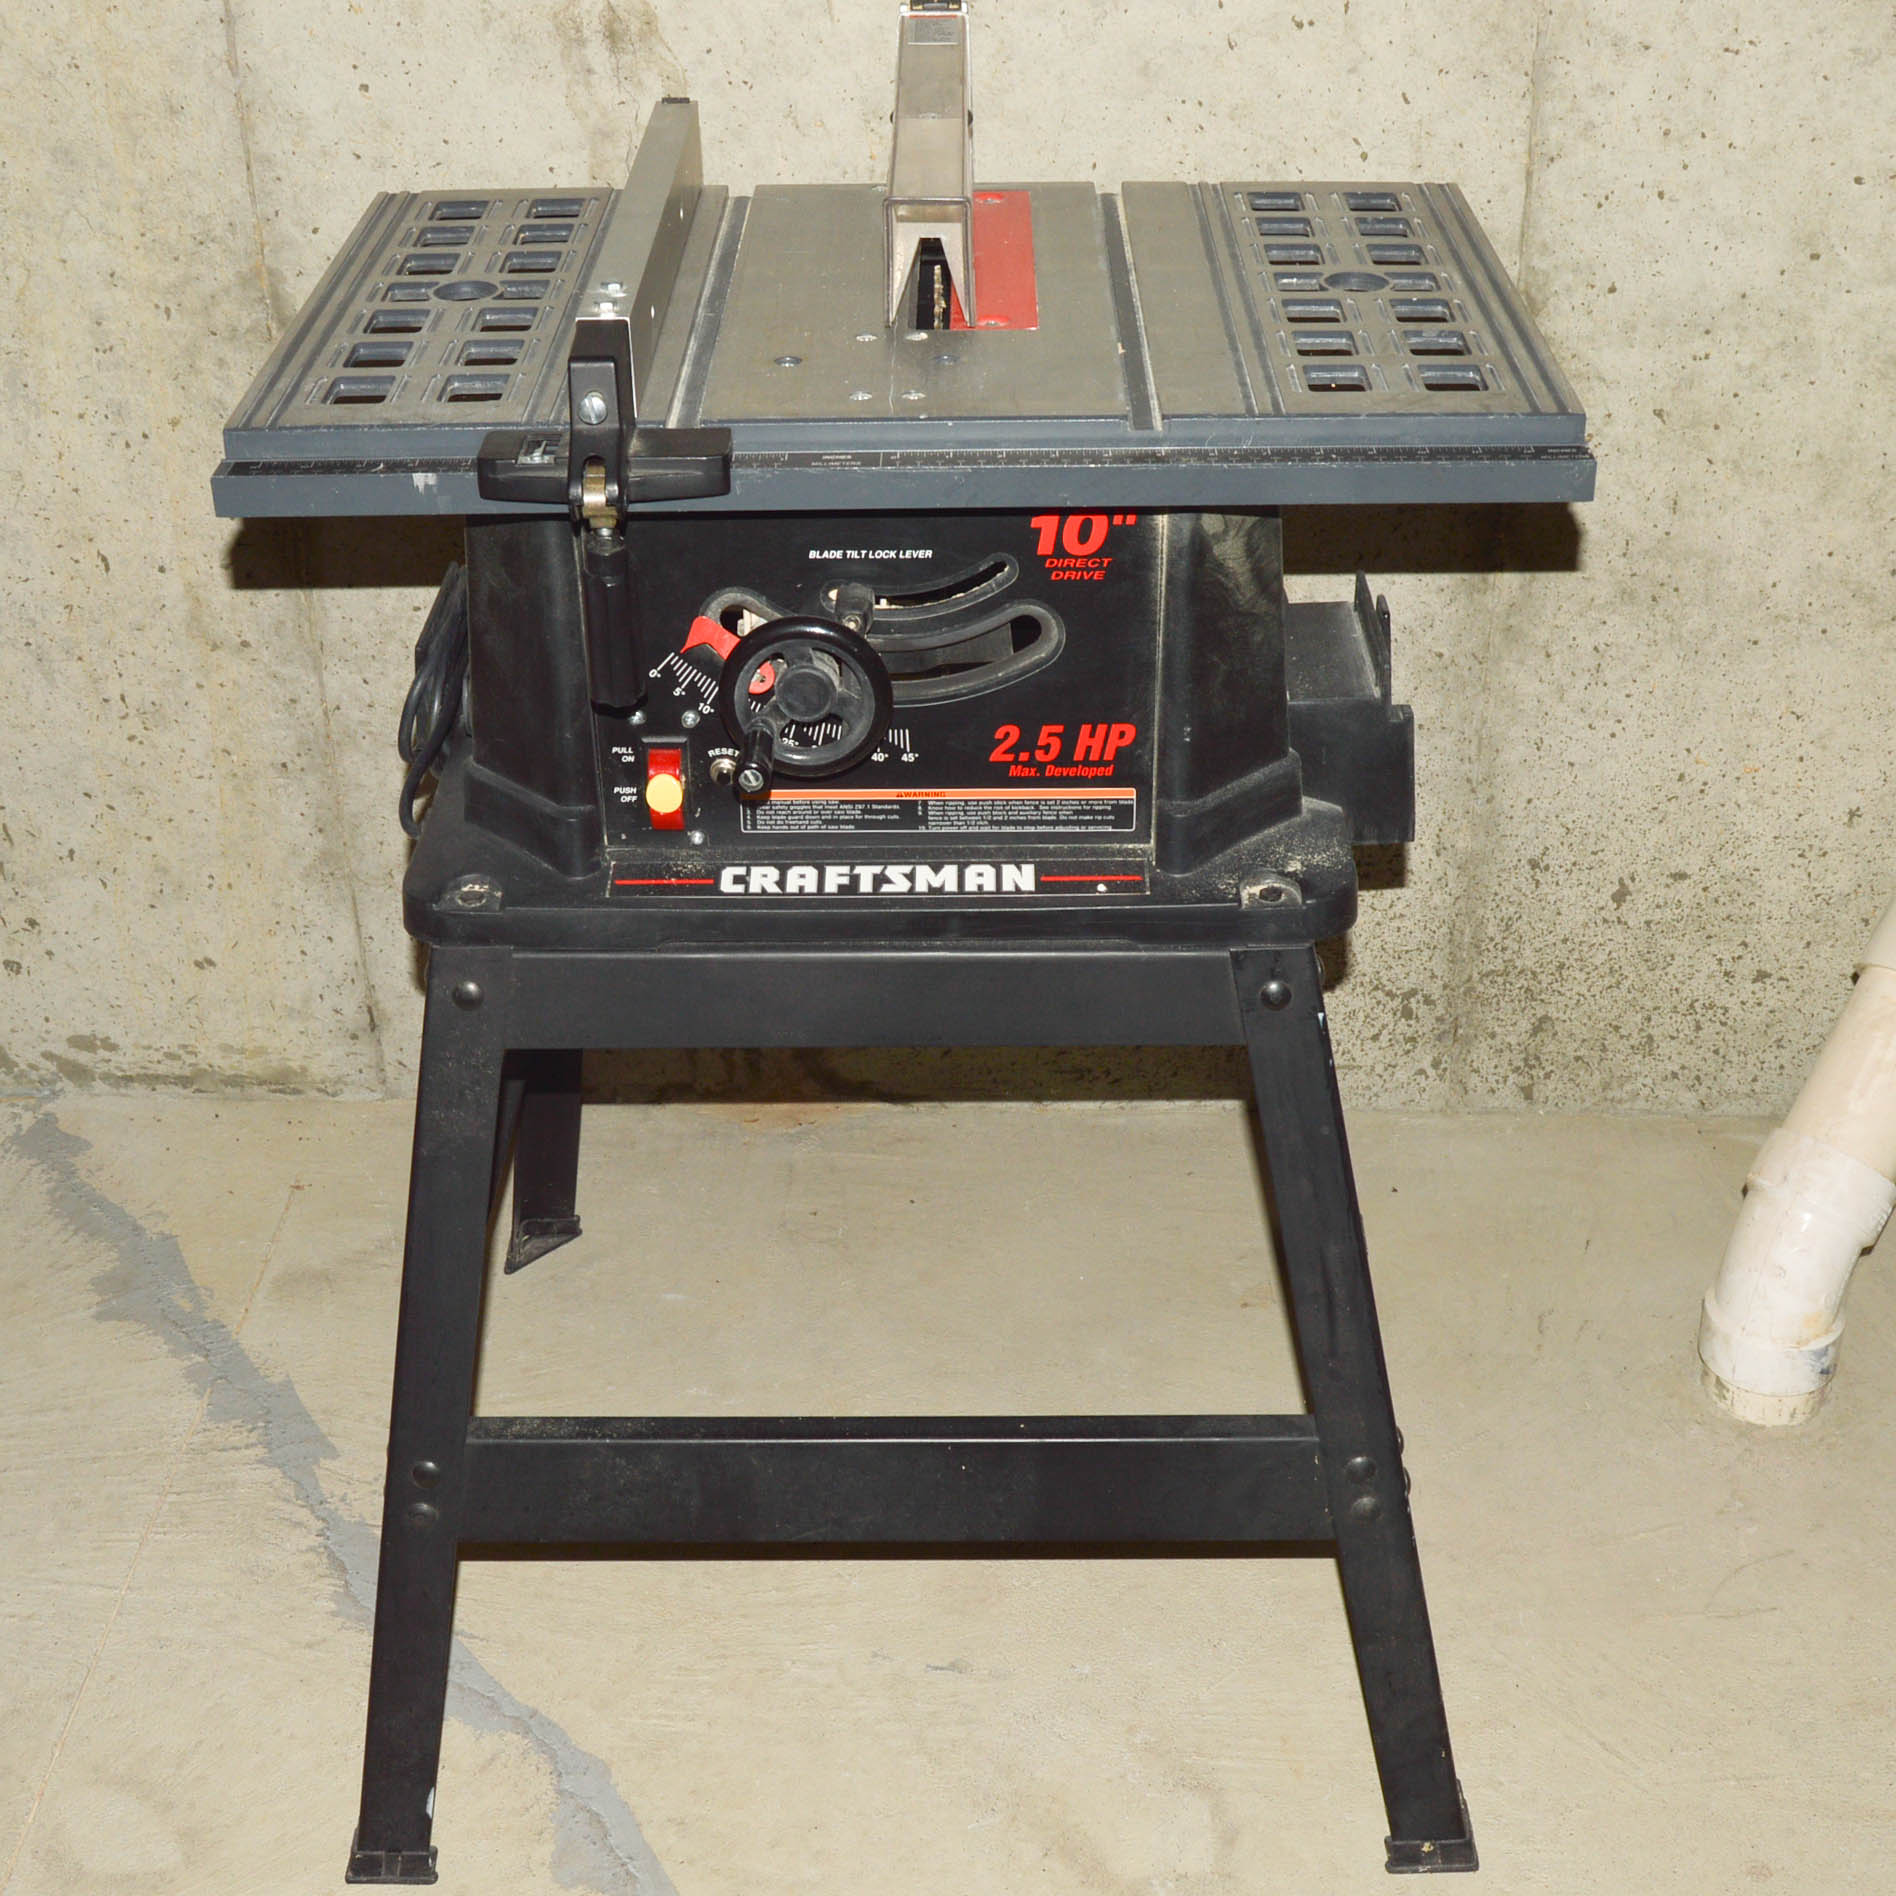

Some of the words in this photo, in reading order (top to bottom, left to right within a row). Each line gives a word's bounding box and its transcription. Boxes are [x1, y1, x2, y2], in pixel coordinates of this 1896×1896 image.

[1030, 514, 1136, 556] 10"
[808, 550, 843, 559] BLADE
[846, 550, 867, 559] TILT
[868, 550, 897, 559] LOCK
[899, 550, 933, 559] LEVER
[1045, 558, 1112, 568] DIRECT
[1051, 570, 1096, 580] DRIVE
[988, 724, 1064, 762] 2.5
[1073, 722, 1136, 762] HP
[708, 747, 740, 758] RESET
[1009, 764, 1040, 777] Max.
[1045, 764, 1114, 779] Developed
[720, 864, 1036, 894] CRAFTSMAN
